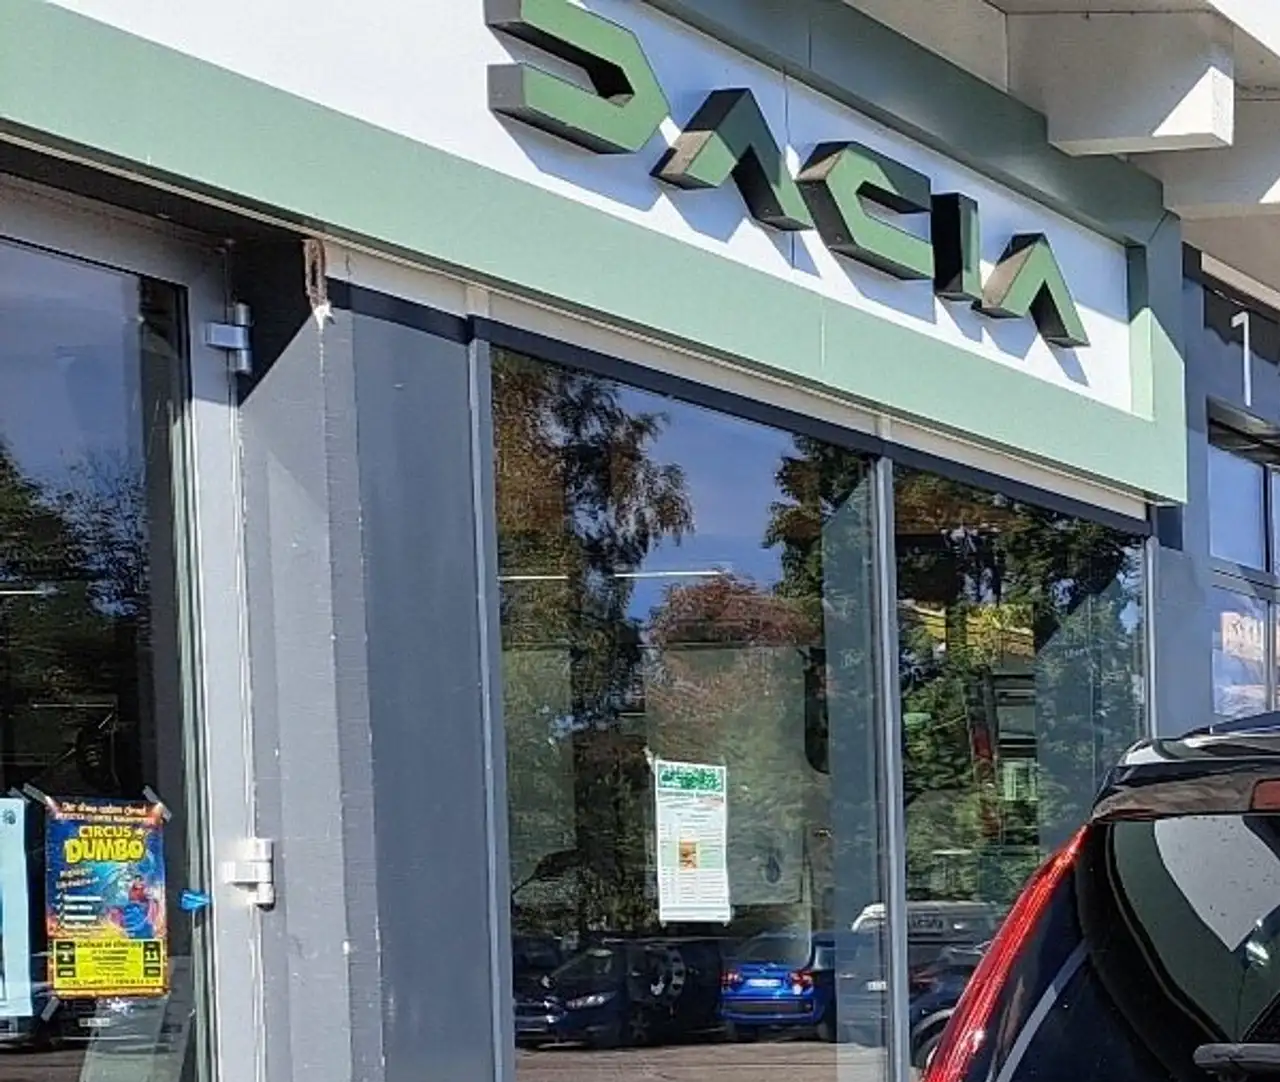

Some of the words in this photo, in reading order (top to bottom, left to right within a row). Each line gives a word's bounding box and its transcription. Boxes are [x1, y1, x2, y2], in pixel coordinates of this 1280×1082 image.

[484, 0, 1090, 348] DACIA
[1231, 310, 1251, 407] 1
[65, 838, 145, 863] DUMBO
[79, 826, 132, 838] CIRCUS
